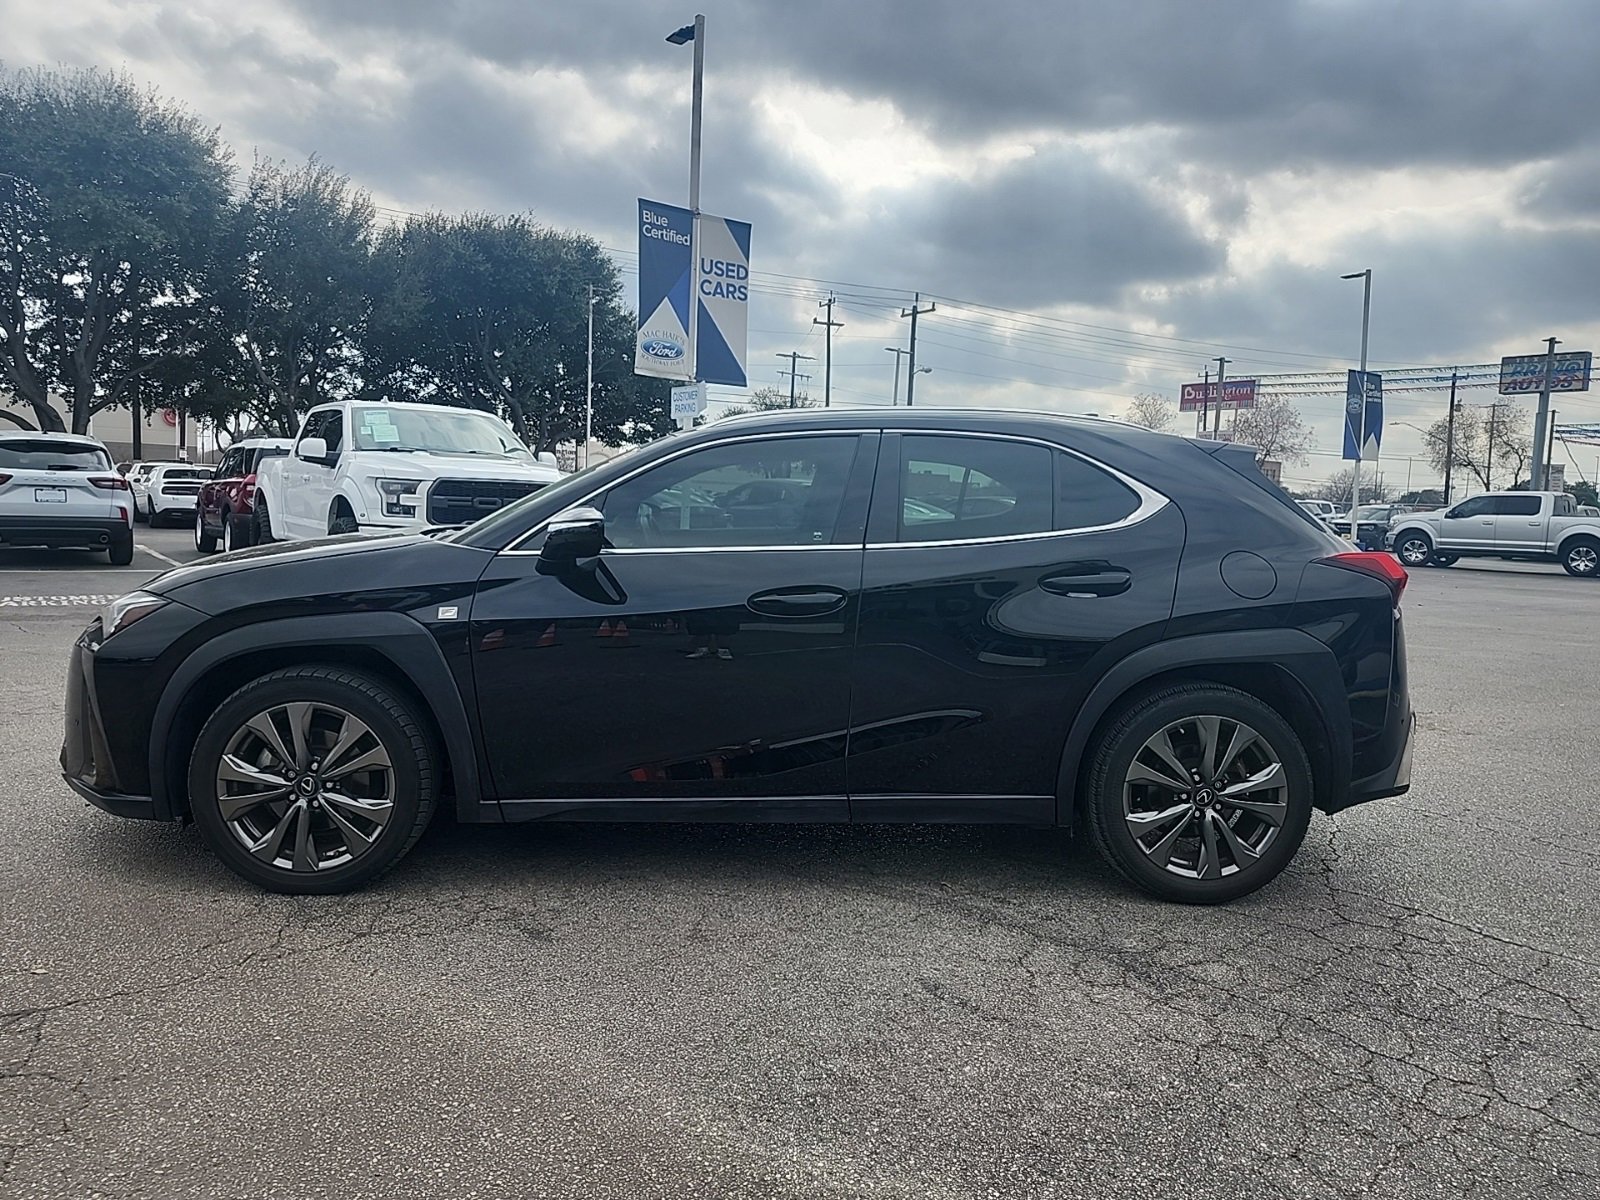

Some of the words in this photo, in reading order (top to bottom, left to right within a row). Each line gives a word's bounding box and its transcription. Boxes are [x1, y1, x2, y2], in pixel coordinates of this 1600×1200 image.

[642, 210, 669, 227] Blue
[642, 224, 691, 247] Certified
[701, 257, 749, 281] USED
[699, 279, 748, 302] CARS
[642, 329, 660, 339] MAC
[648, 340, 678, 358] Ford
[1184, 385, 1251, 401] Buligton
[675, 402, 696, 414] PARKING
